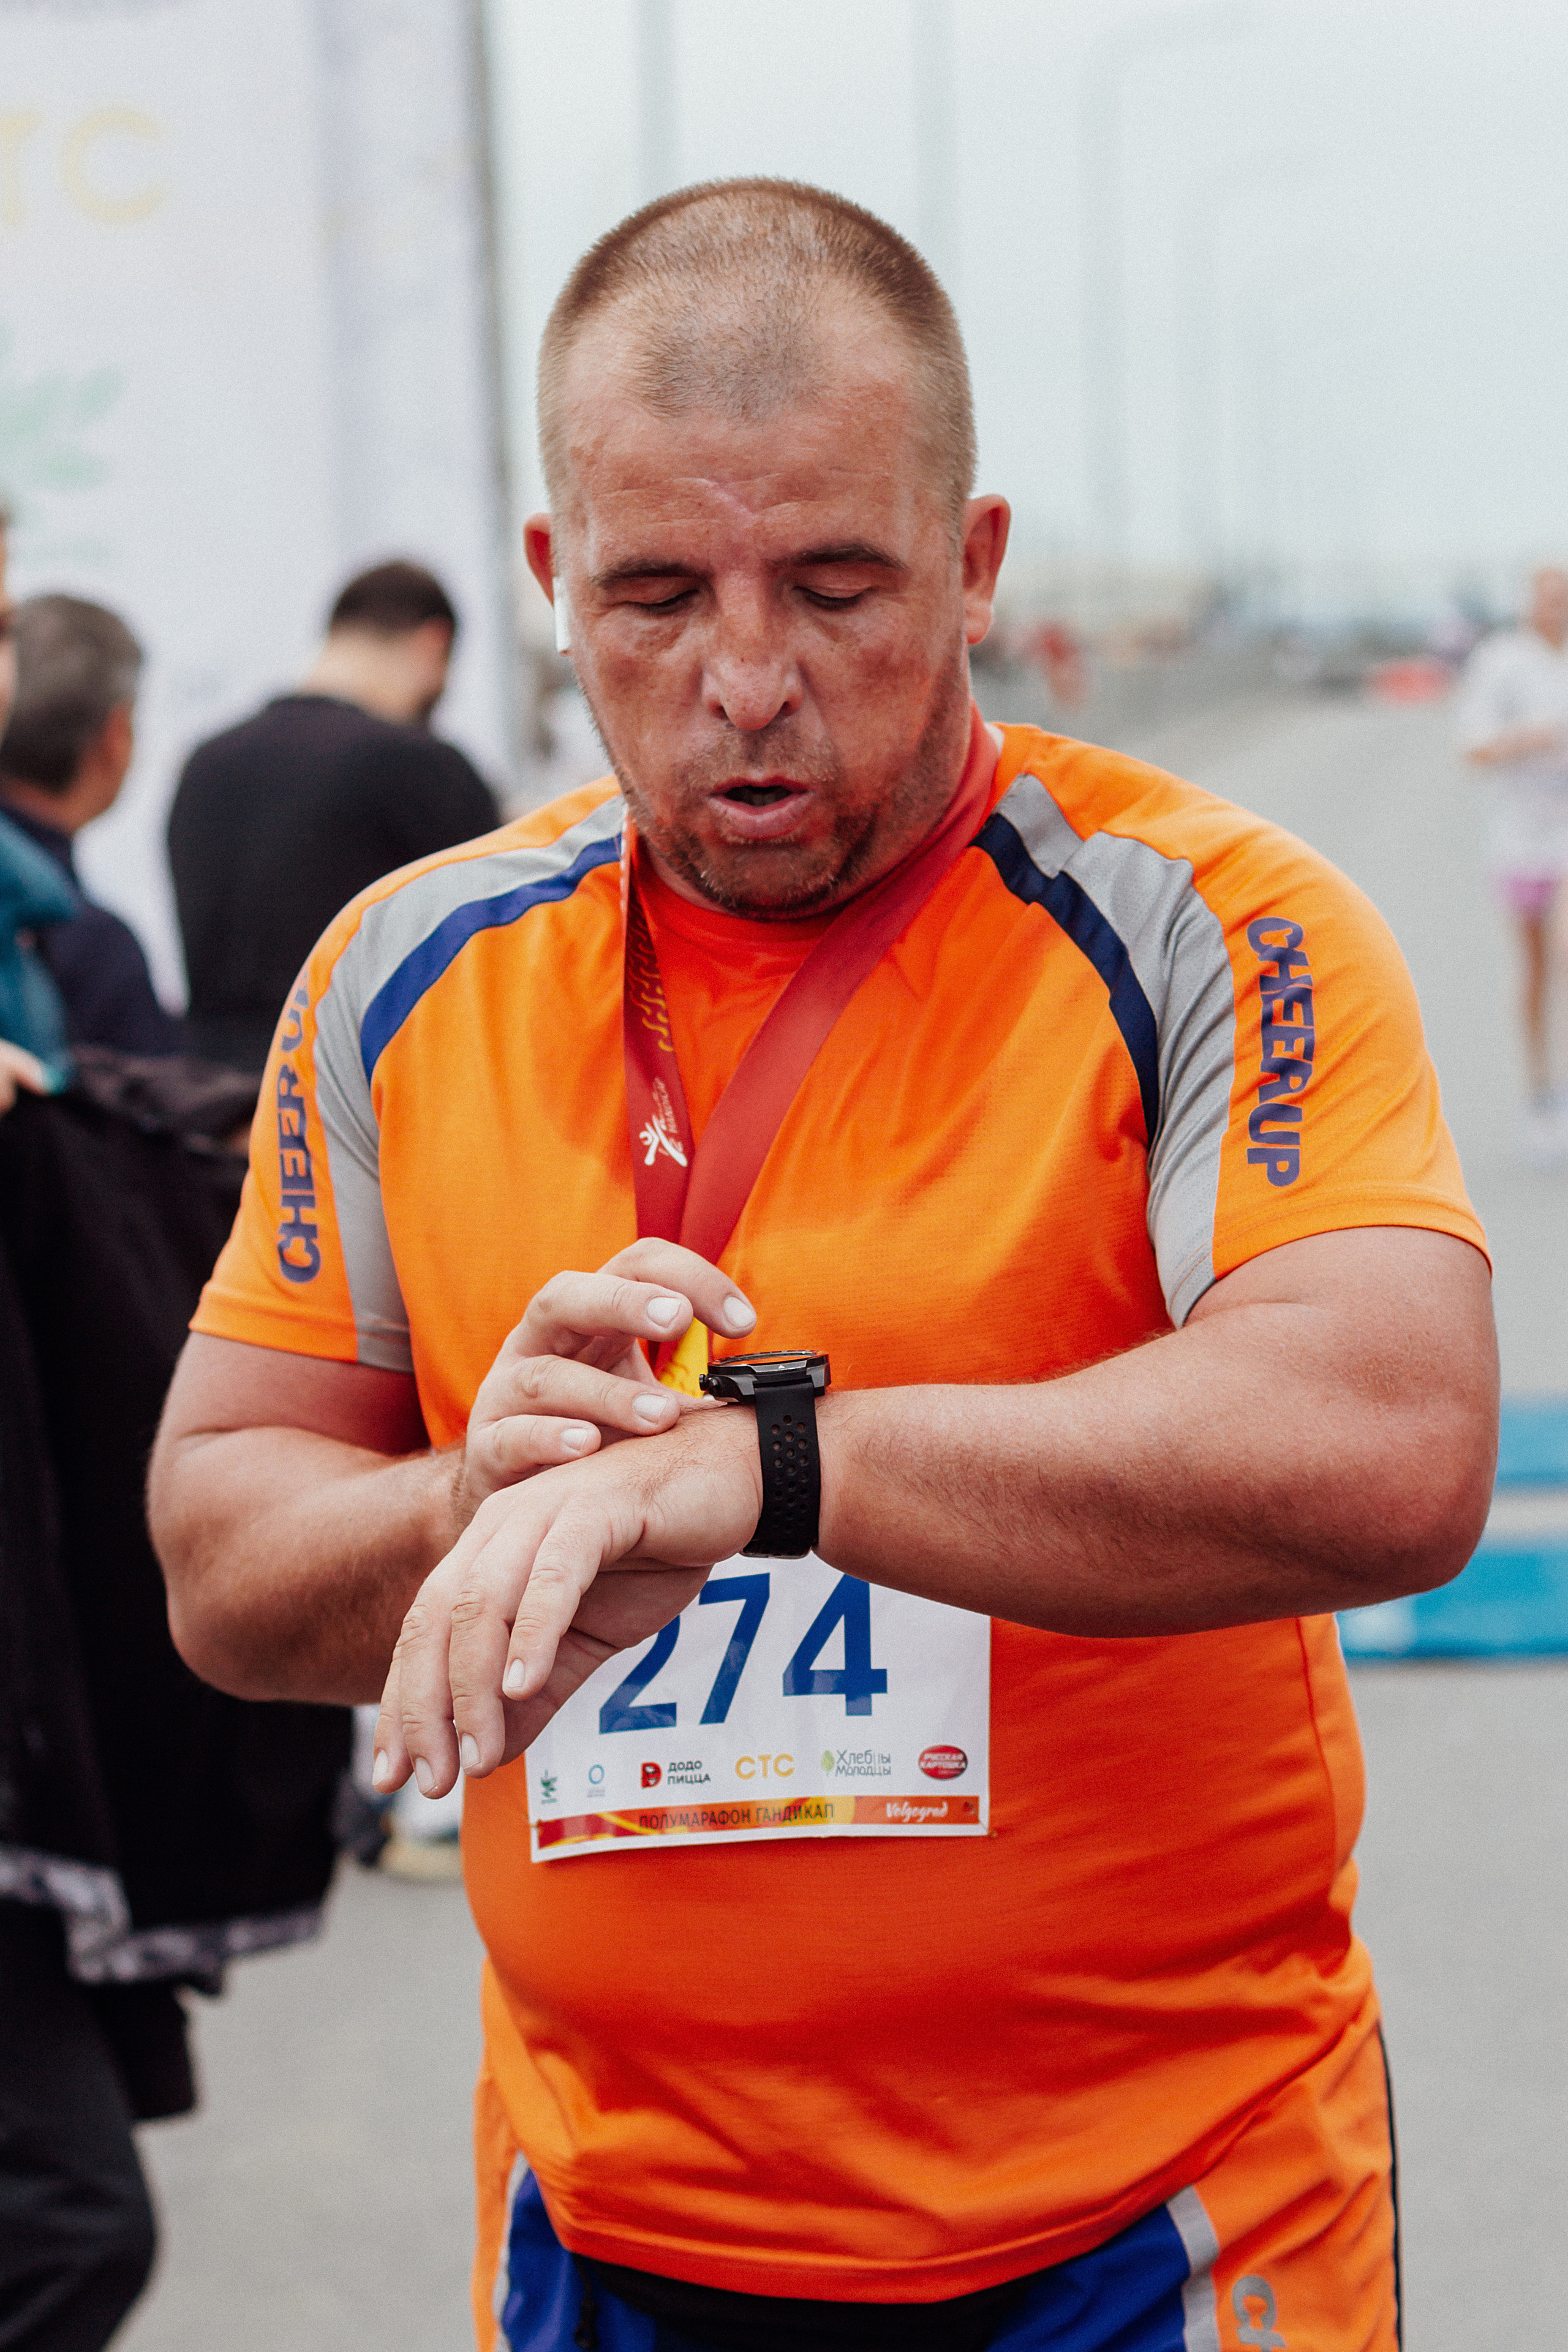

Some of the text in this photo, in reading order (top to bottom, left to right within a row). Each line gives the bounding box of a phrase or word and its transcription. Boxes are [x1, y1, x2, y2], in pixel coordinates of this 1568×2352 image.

[1246, 916, 1315, 1188] CHEERUP
[599, 1572, 888, 1735] 274
[667, 1773, 711, 1785] ПИЦЦА
[735, 1753, 795, 1781] СТС
[639, 1804, 834, 1830] ПОЛУМАРАФОН ГАНДИКАП
[886, 1801, 948, 1823] Volgograd
